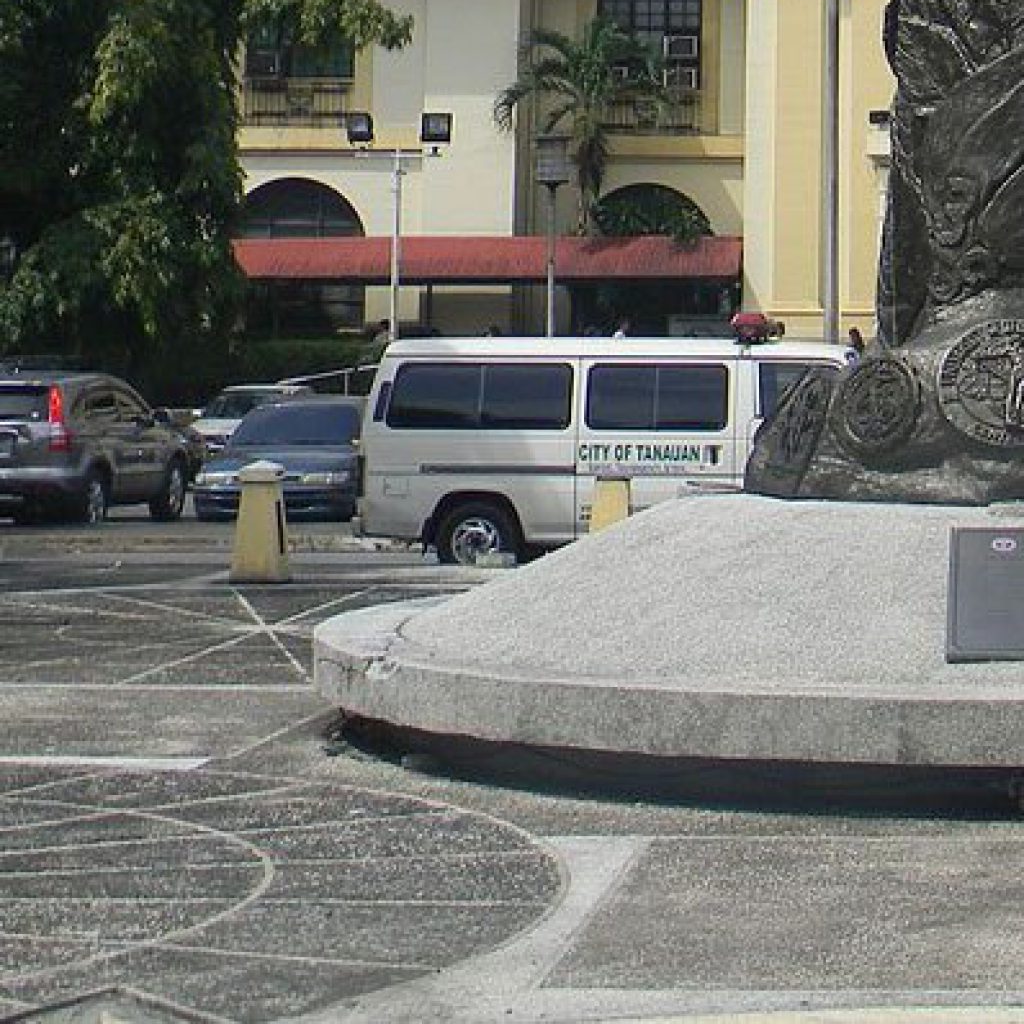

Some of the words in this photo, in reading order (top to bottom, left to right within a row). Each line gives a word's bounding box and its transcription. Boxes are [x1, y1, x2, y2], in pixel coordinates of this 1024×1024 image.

[579, 444, 610, 462] CITY
[614, 444, 632, 462] OF
[635, 444, 701, 462] TANAUAN
